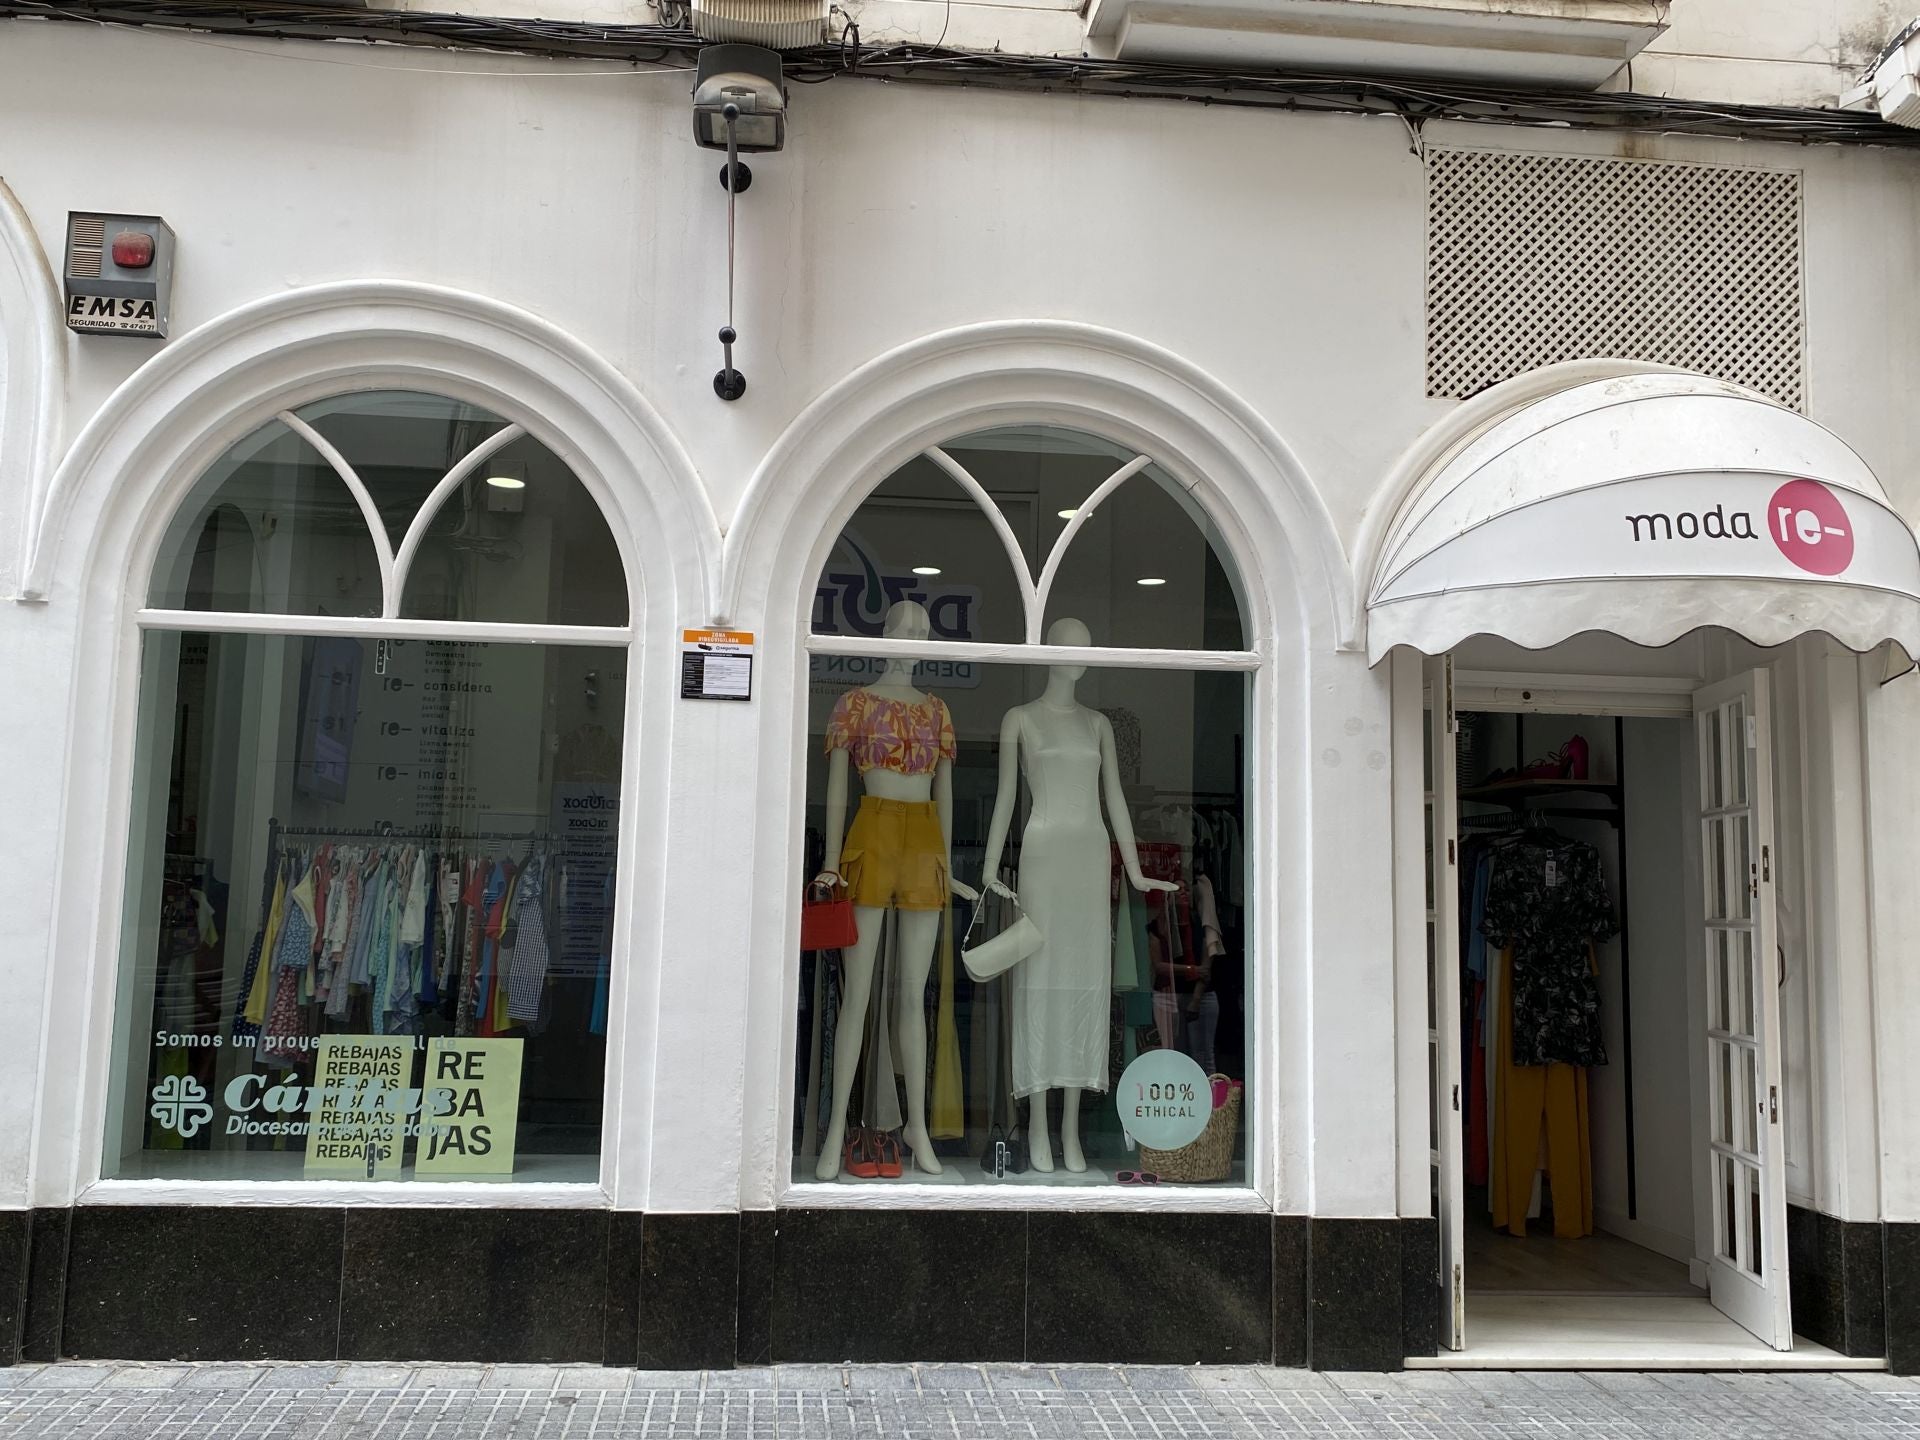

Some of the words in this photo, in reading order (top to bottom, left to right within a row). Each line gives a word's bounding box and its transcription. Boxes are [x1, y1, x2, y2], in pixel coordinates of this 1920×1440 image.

[70, 296, 155, 320] EMSA
[69, 319, 116, 328] SEGURIDAD
[1626, 503, 1758, 542] moda
[384, 677, 414, 692] re-
[424, 681, 493, 693] considera
[380, 721, 412, 736] re-
[421, 725, 475, 737] vitaliza
[377, 765, 409, 781] re-
[418, 769, 456, 781] inicia
[155, 1030, 223, 1048] Somos
[232, 1034, 256, 1048] un
[328, 1045, 402, 1061] REBAJAS
[326, 1061, 401, 1077] REBAJAS
[436, 1050, 486, 1080] RE
[1135, 1082, 1195, 1102] 100%
[1135, 1105, 1196, 1118] ETHICAL
[426, 1125, 492, 1160] JAS
[316, 1144, 392, 1160] REBAJS
